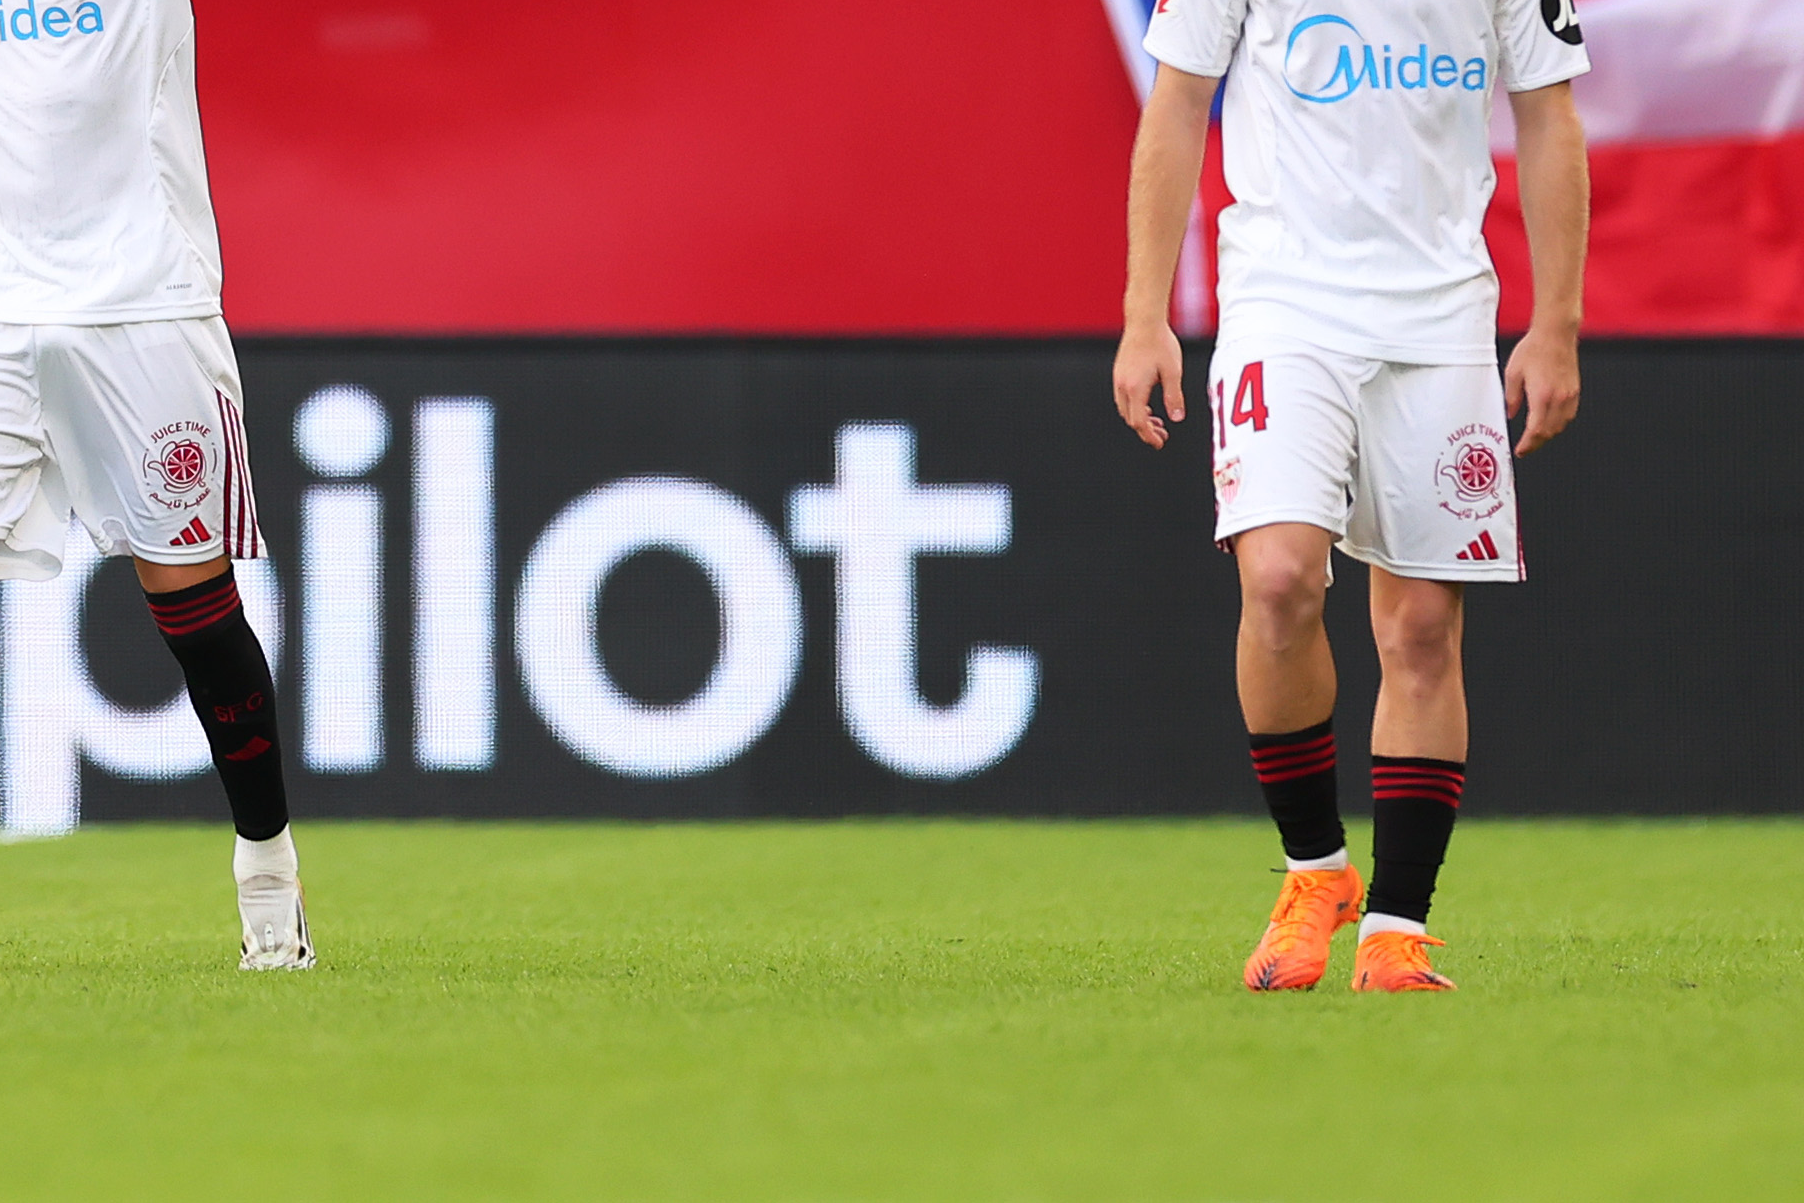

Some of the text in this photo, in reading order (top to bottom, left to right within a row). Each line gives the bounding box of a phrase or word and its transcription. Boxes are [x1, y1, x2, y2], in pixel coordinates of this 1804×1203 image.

[1281, 13, 1487, 104] Midea
[150, 420, 212, 443] JUICE TIME
[1216, 360, 1269, 450] 14
[1446, 423, 1505, 446] JUICE TIME
